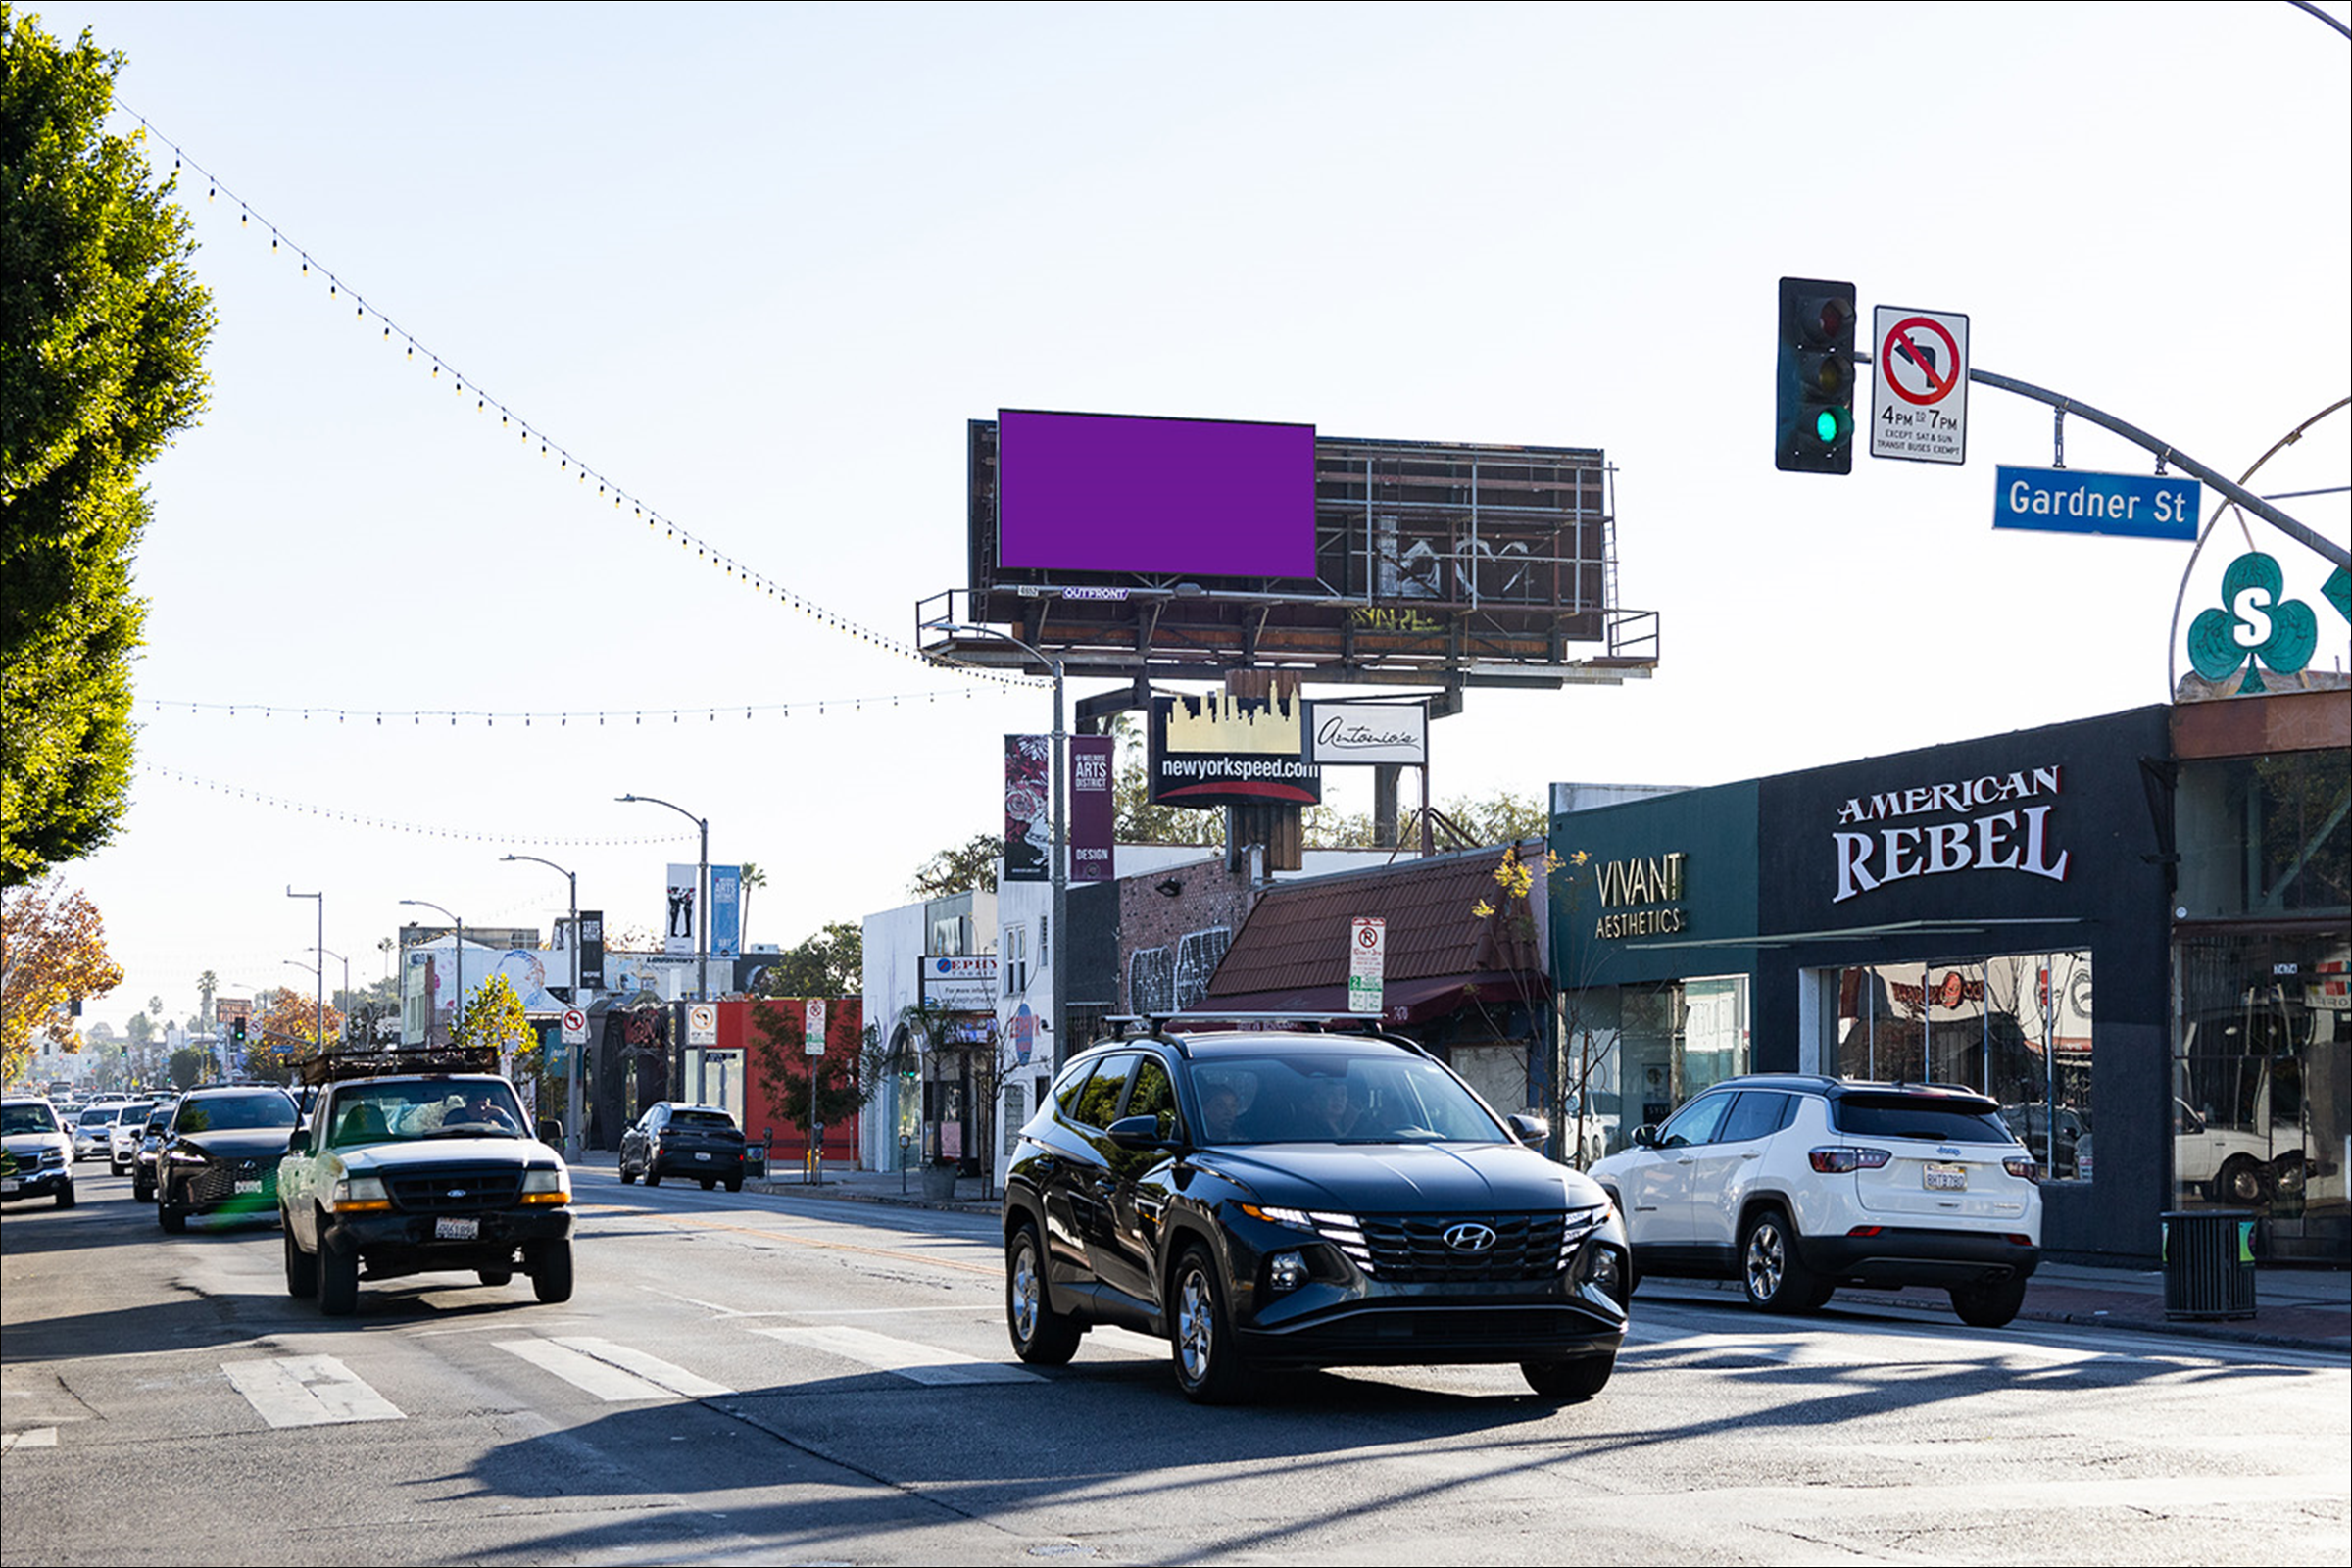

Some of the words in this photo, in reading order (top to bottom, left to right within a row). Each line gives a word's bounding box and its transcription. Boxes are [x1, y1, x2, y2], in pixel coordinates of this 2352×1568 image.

[1882, 405, 1913, 426] 4PM
[1929, 409, 1957, 431] 7PM
[1885, 429, 1913, 439] EXCEPT
[1877, 439, 1905, 450] TRANSIT
[1907, 442, 1931, 452] BUSES
[1933, 445, 1960, 455] EXEMPT
[2010, 480, 2140, 520] Gardner
[2153, 489, 2186, 523] St
[1063, 587, 1126, 599] OUTFRONT
[1317, 716, 1422, 751] Antonio's
[1076, 762, 1106, 778] ARTS
[1162, 758, 1319, 781] newyorkspeed.com
[1076, 778, 1106, 788] DISTRICT
[1838, 765, 2061, 824] AMERICAN
[1076, 849, 1108, 860] DESIGN
[1832, 805, 2070, 903] REBEL
[1595, 852, 1681, 907] VIVANT
[1595, 907, 1680, 939] AESTHETICS
